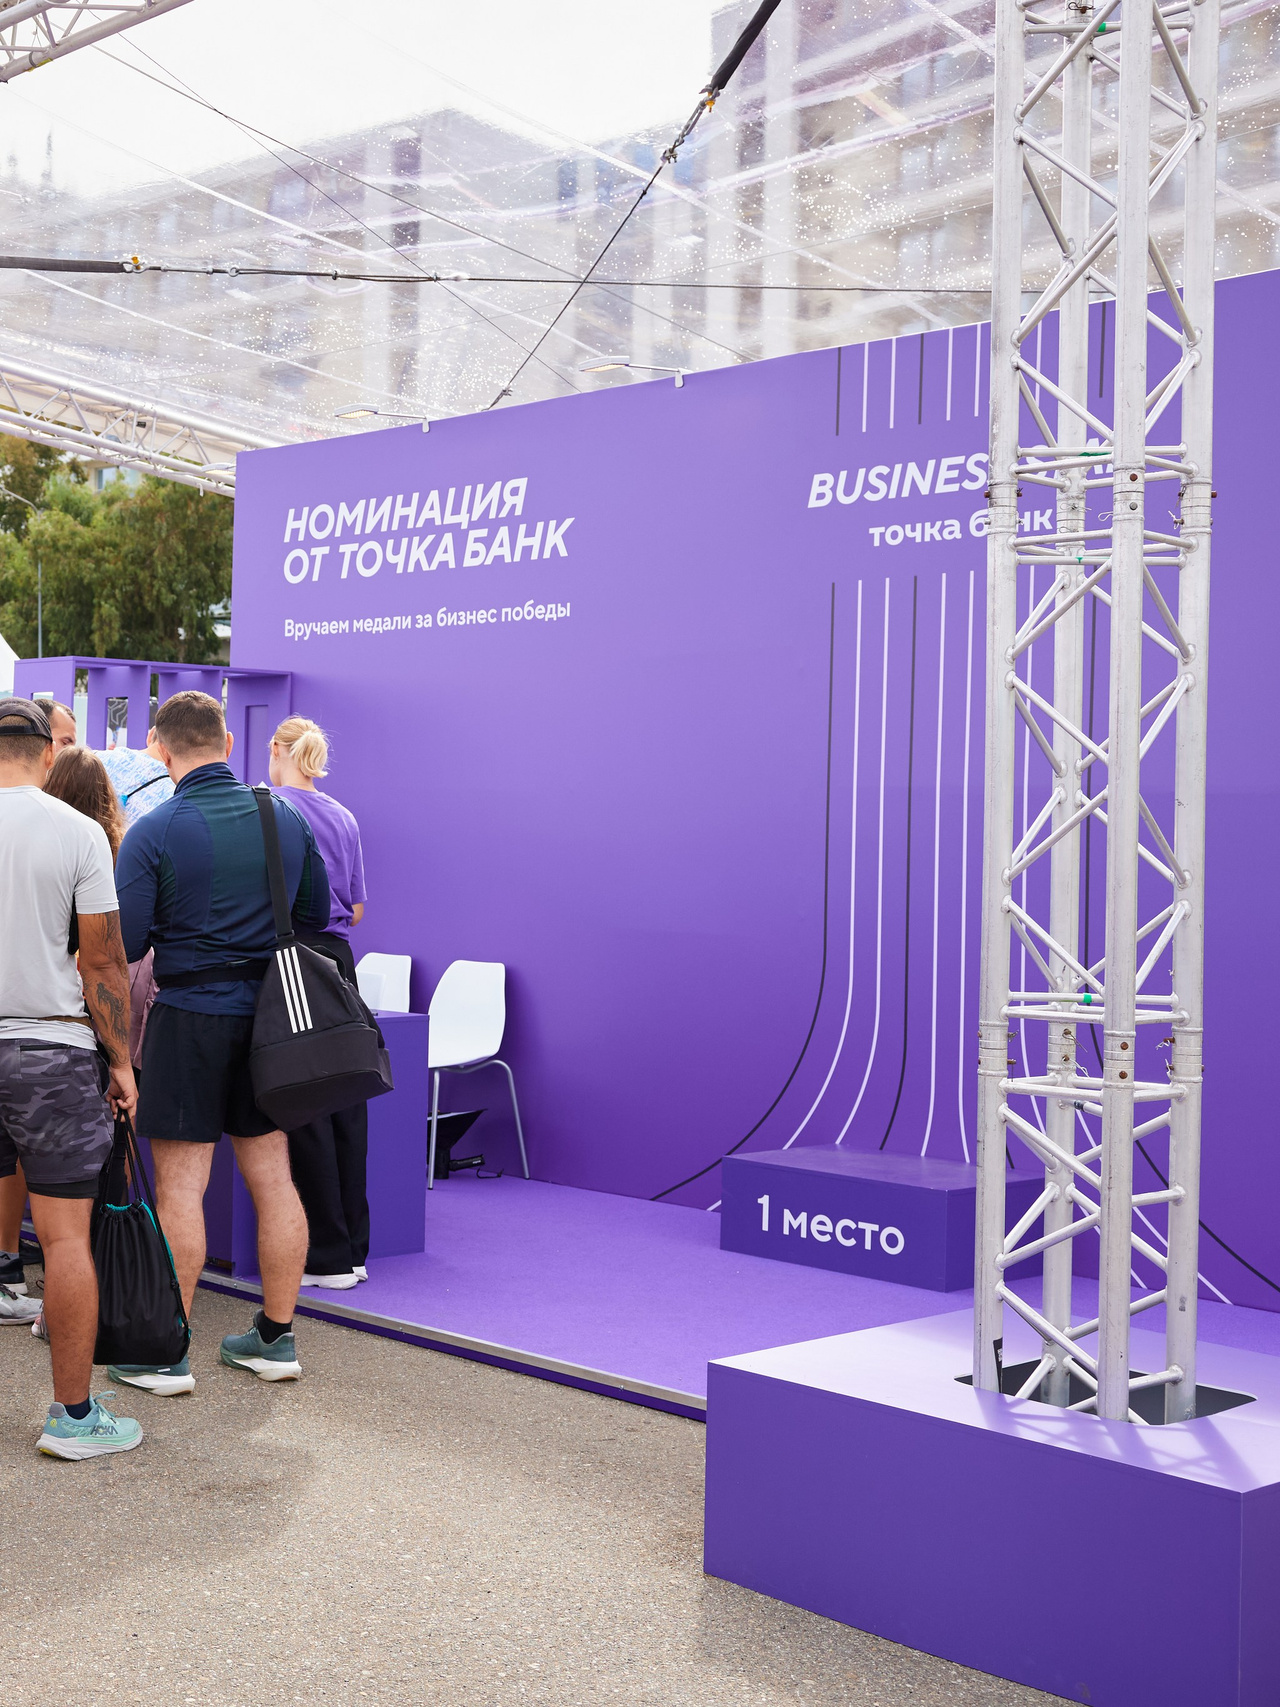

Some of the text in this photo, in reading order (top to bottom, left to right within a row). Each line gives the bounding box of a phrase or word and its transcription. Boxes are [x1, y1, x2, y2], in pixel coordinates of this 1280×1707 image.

[808, 452, 990, 509] BUSINES
[283, 477, 528, 543] НОМИНАЦИЯ
[869, 508, 1053, 547] точка бнк
[283, 517, 575, 584] ОТ ТОЧКА БАНК
[284, 599, 571, 641] Вручаем медали за бизнес победы
[757, 1194, 905, 1256] 1 место
[90, 1425, 119, 1436] HOKA
